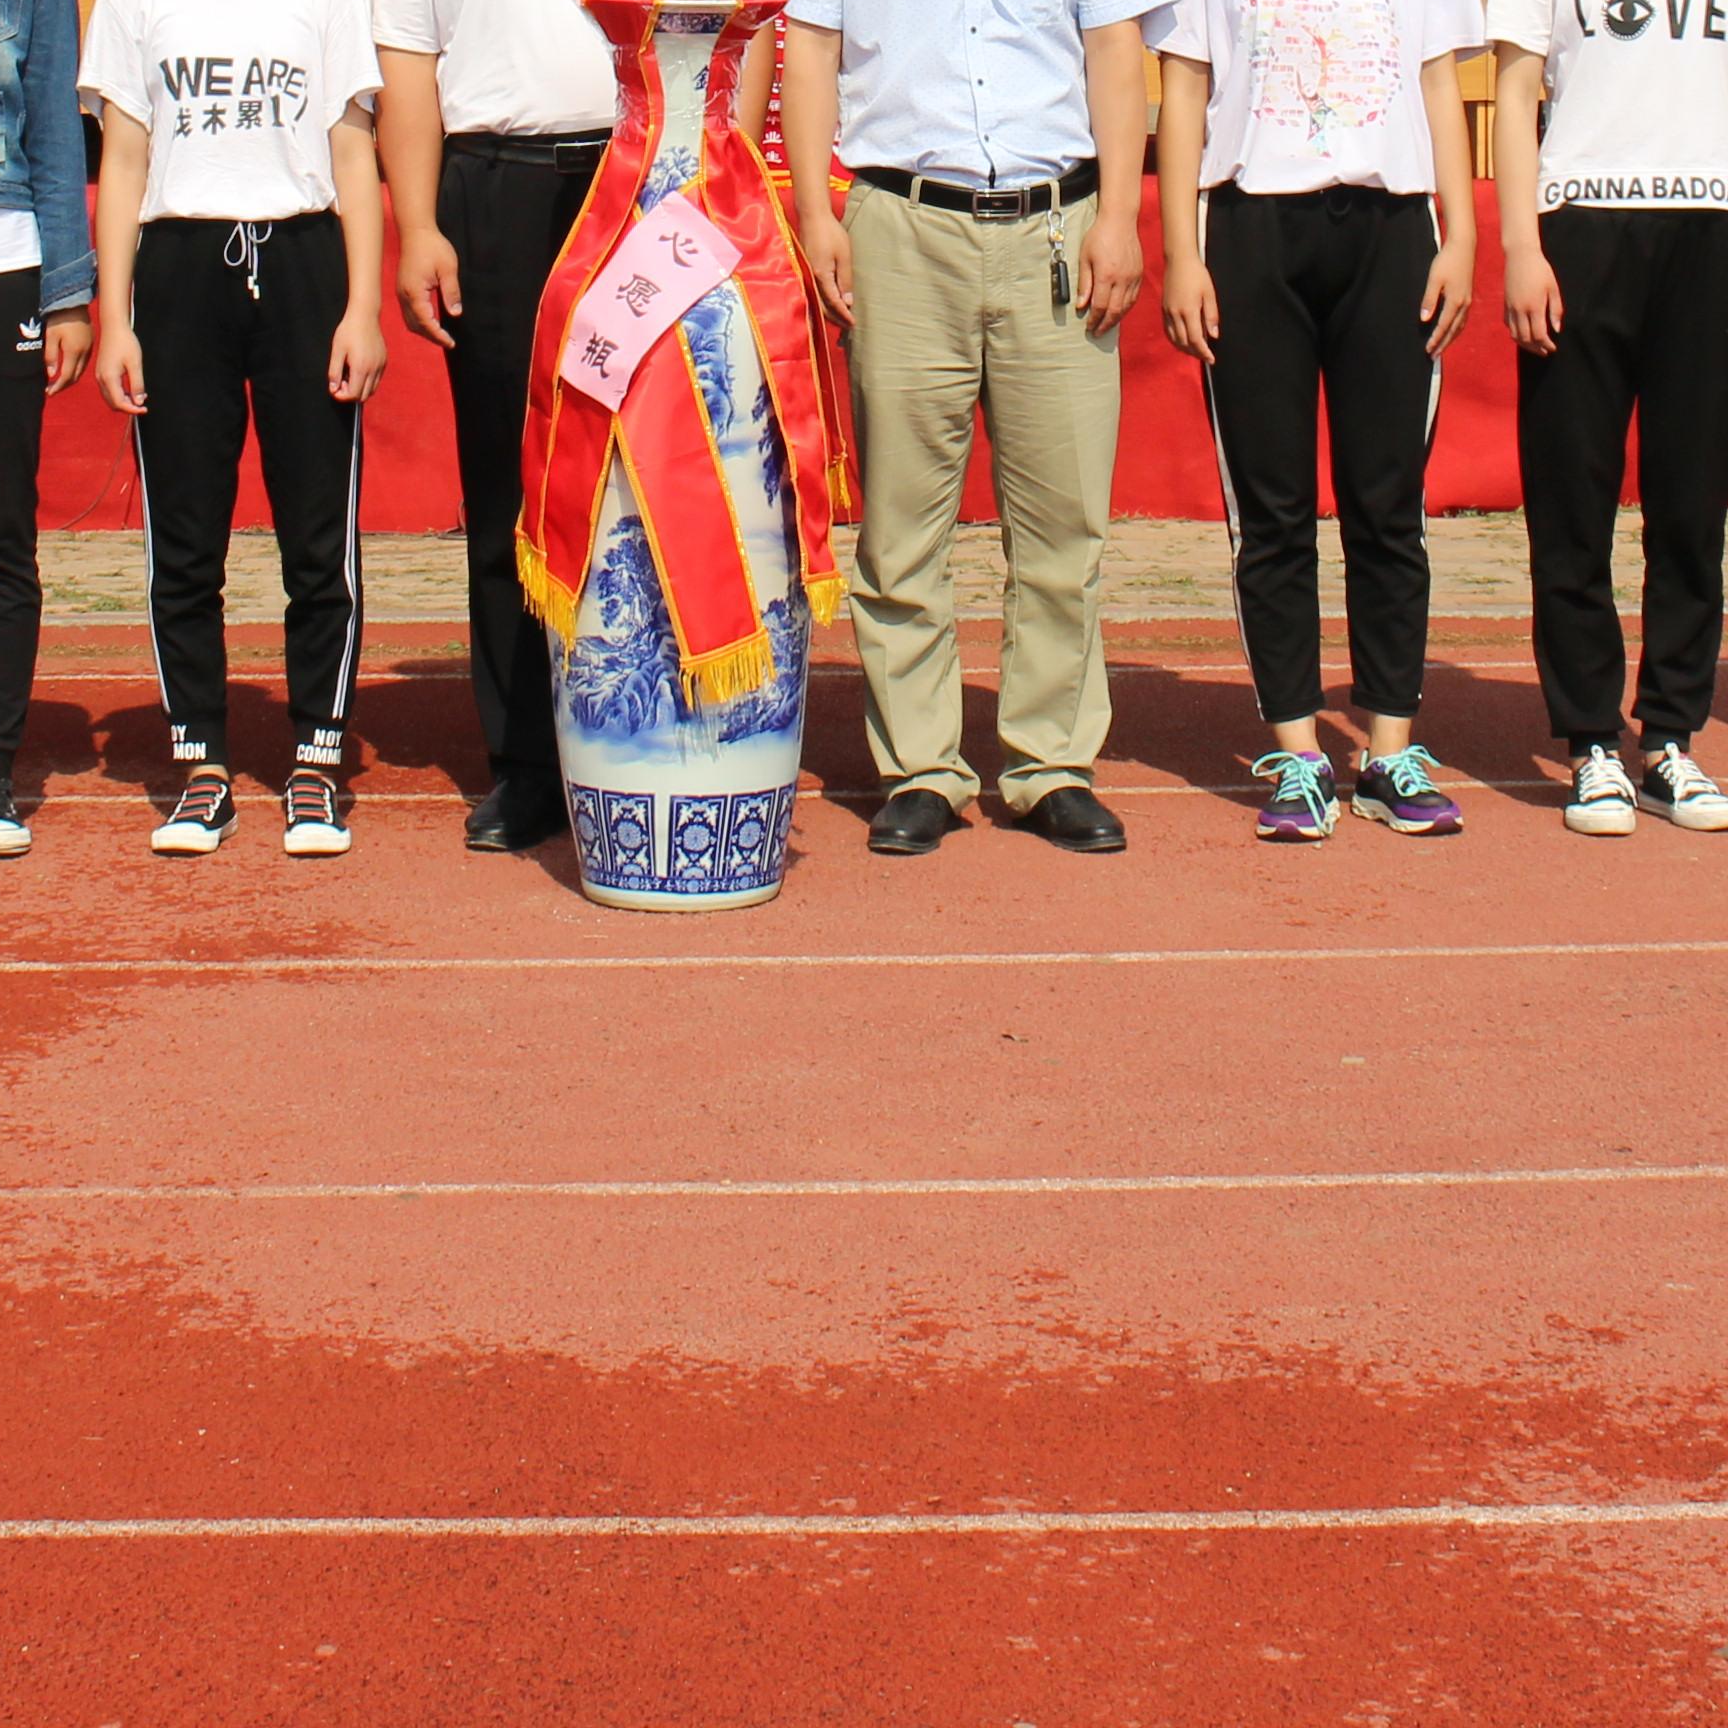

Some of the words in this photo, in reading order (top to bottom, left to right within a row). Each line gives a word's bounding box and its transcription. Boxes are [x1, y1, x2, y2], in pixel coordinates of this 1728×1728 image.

[159, 56, 233, 101] WE
[241, 57, 307, 100] ARE
[1544, 178, 1646, 205] GONNA
[581, 231, 699, 379] 心愿瓶
[296, 744, 342, 766] COMM
